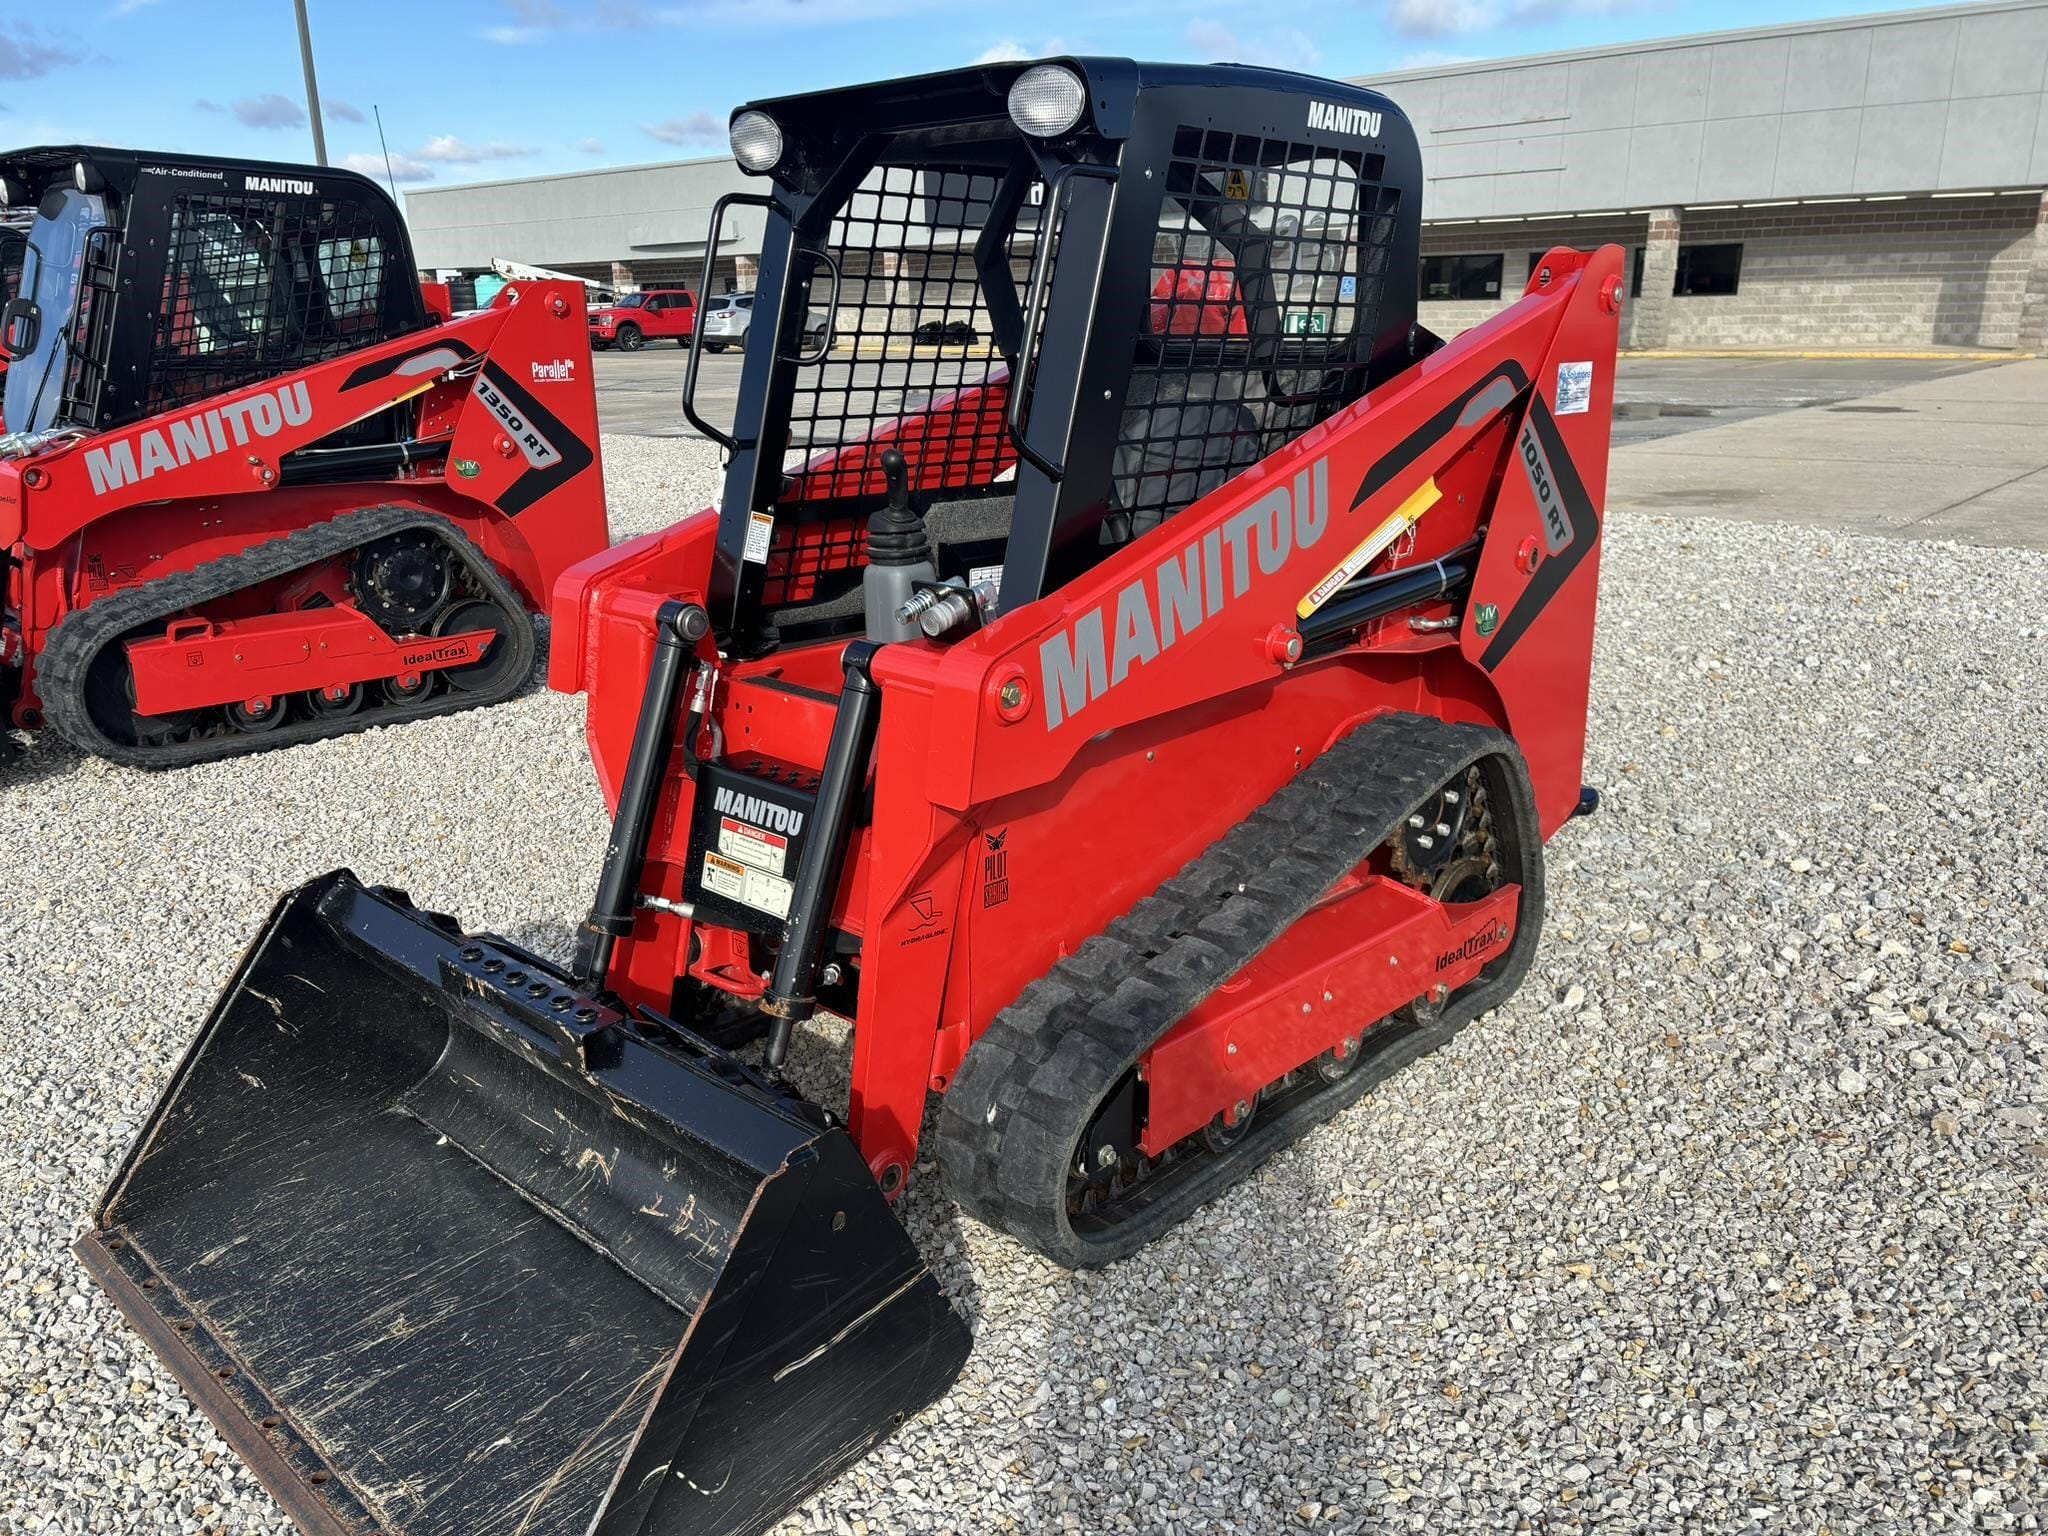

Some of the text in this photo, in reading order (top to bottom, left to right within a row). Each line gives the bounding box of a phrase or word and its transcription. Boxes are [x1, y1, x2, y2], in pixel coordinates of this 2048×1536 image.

[1307, 101, 1382, 138] MANITOU
[154, 167, 224, 180] Air-Conditioned
[245, 176, 314, 195] MANITOU
[478, 381, 550, 458] 1350 RT
[84, 380, 313, 496] MANITOU
[1519, 428, 1567, 541] 1050 RT
[1039, 455, 1328, 732] MANITOU
[1319, 570, 1346, 597] DANGER
[403, 645, 467, 665] IdealTrax
[713, 786, 804, 837] MANITOU
[716, 857, 740, 874] WARNING
[985, 850, 1008, 883] PILOT
[984, 879, 1009, 908] SERIES
[900, 928, 946, 947] HYDRAGLIDE
[1435, 929, 1494, 972] IdealTrax
